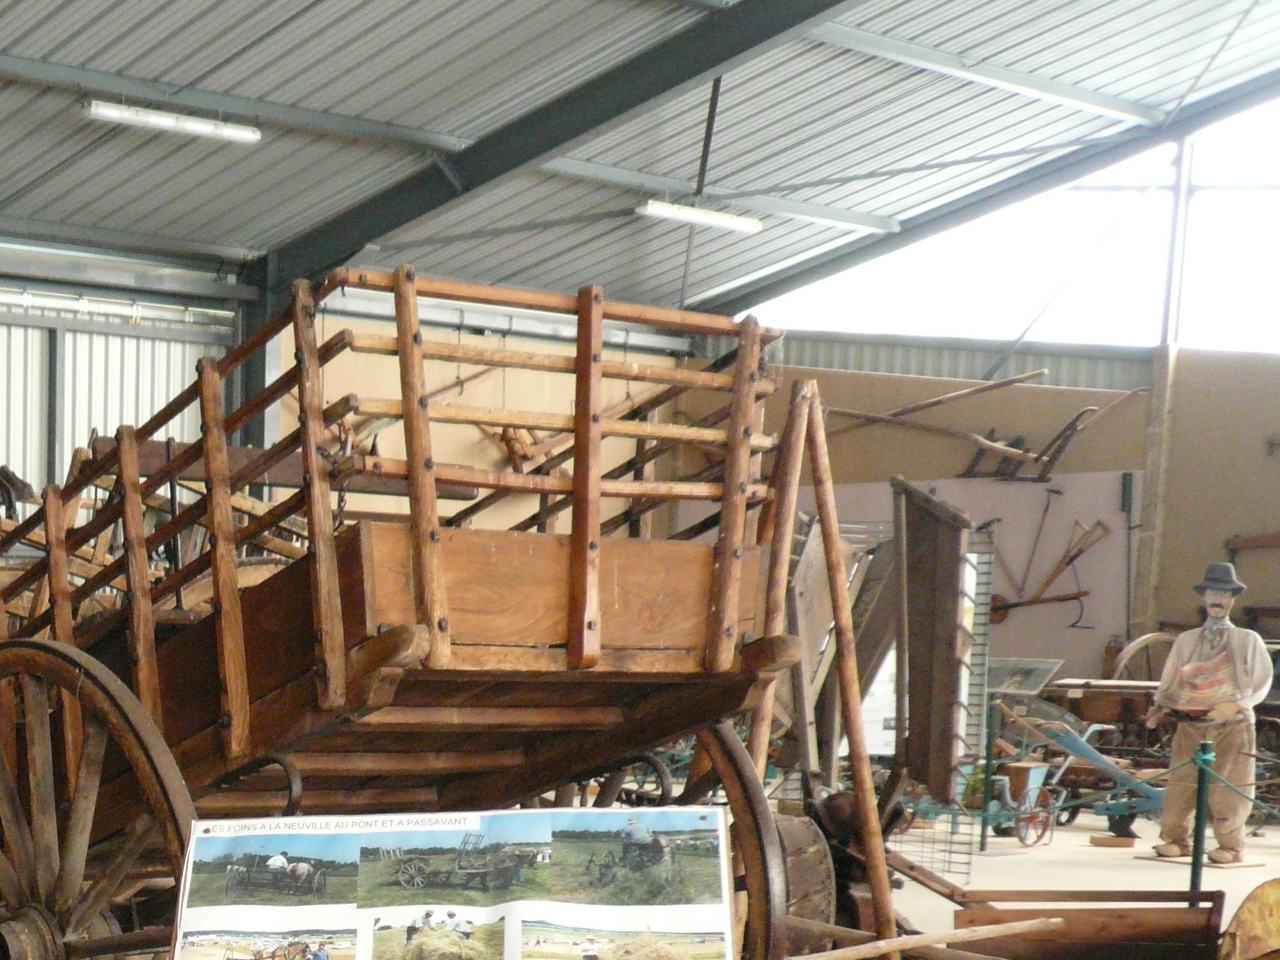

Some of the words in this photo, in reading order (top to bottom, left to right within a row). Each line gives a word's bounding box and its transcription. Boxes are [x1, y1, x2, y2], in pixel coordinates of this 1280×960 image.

[228, 823, 257, 833] FOINS
[260, 822, 268, 831] A
[269, 822, 281, 831] LA
[284, 821, 331, 830] NEUVILLE
[334, 821, 348, 829] AU
[351, 820, 380, 829] PONT
[382, 819, 395, 828] ET
[397, 819, 404, 827] A
[407, 817, 469, 827] PASSAVANT
